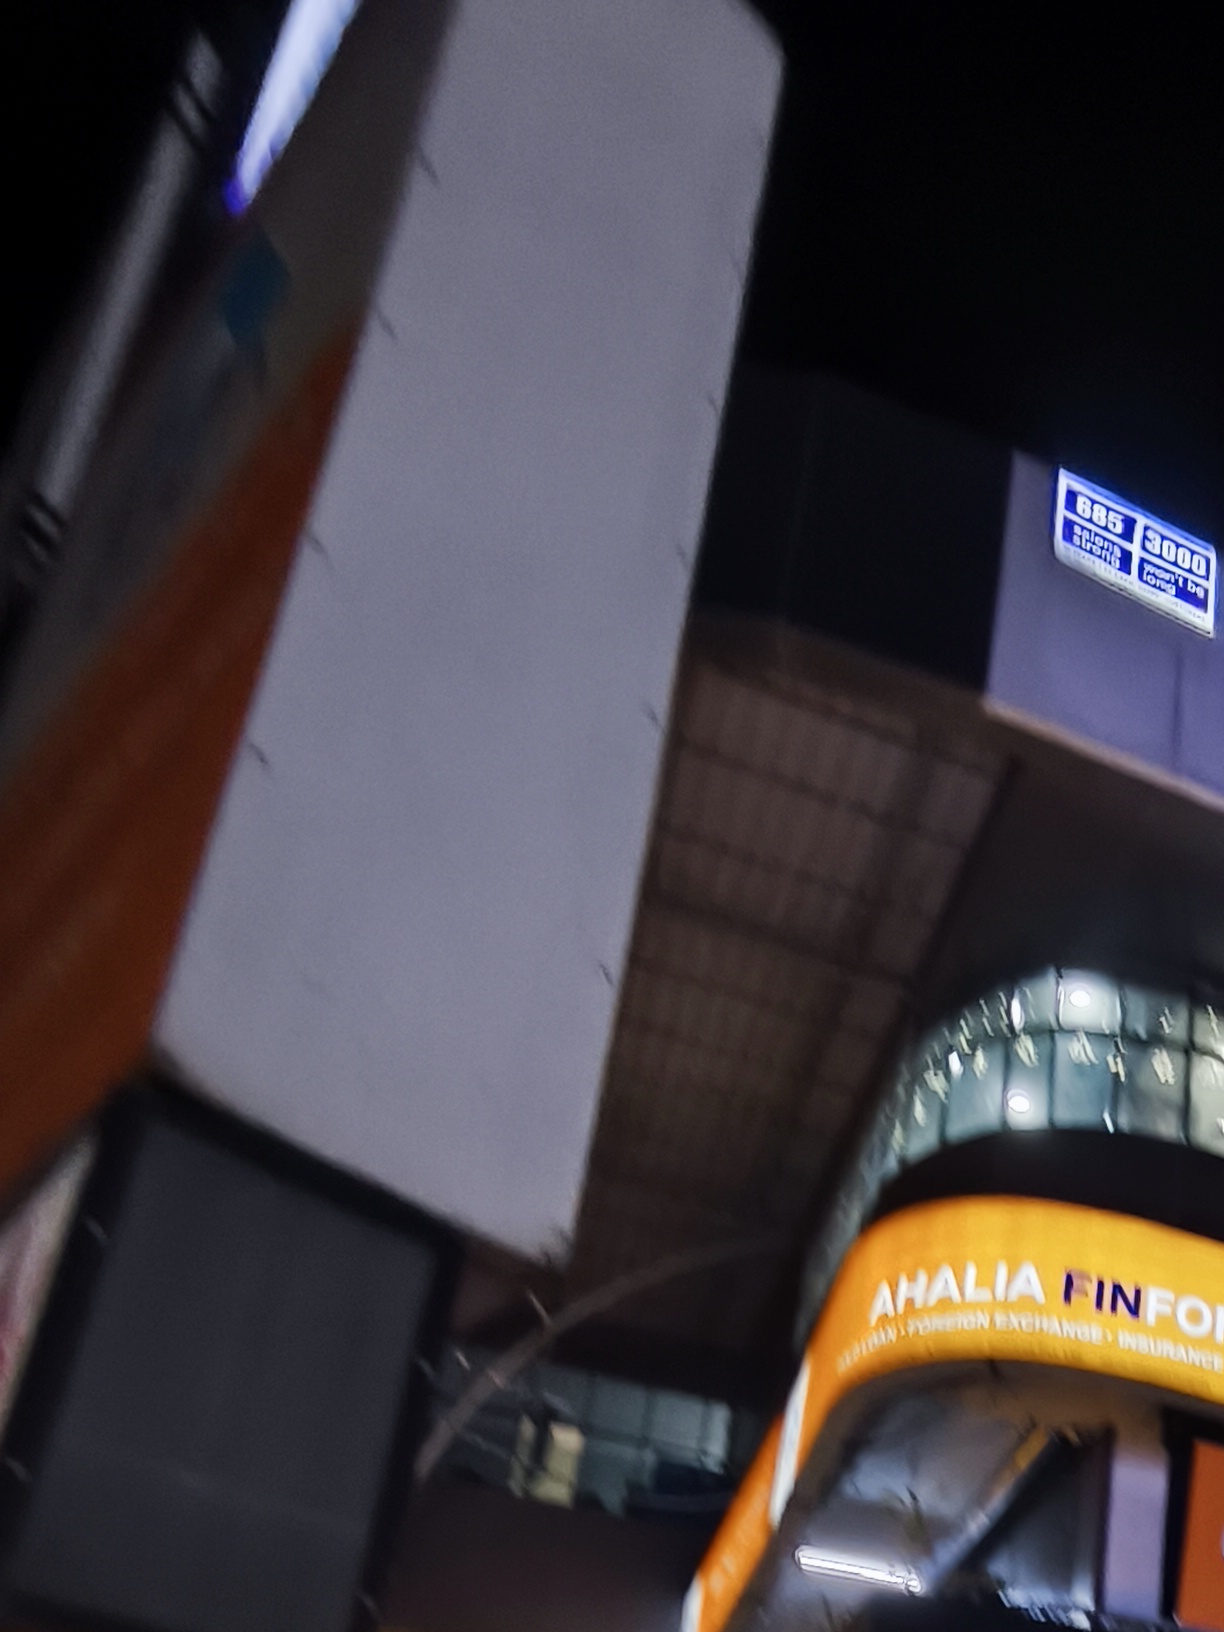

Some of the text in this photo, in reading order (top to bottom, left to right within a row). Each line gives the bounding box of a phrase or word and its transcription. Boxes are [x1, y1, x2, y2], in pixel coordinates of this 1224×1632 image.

[1076, 494, 1125, 535] 685
[1073, 524, 1121, 558] salons
[1144, 528, 1207, 577] 3000
[1142, 569, 1177, 597] long
[1187, 578, 1205, 599] be
[868, 1260, 1046, 1327] AHALIA
[994, 1310, 1104, 1346] EXCHANGE
[1118, 1328, 1224, 1374] INSURANCE
